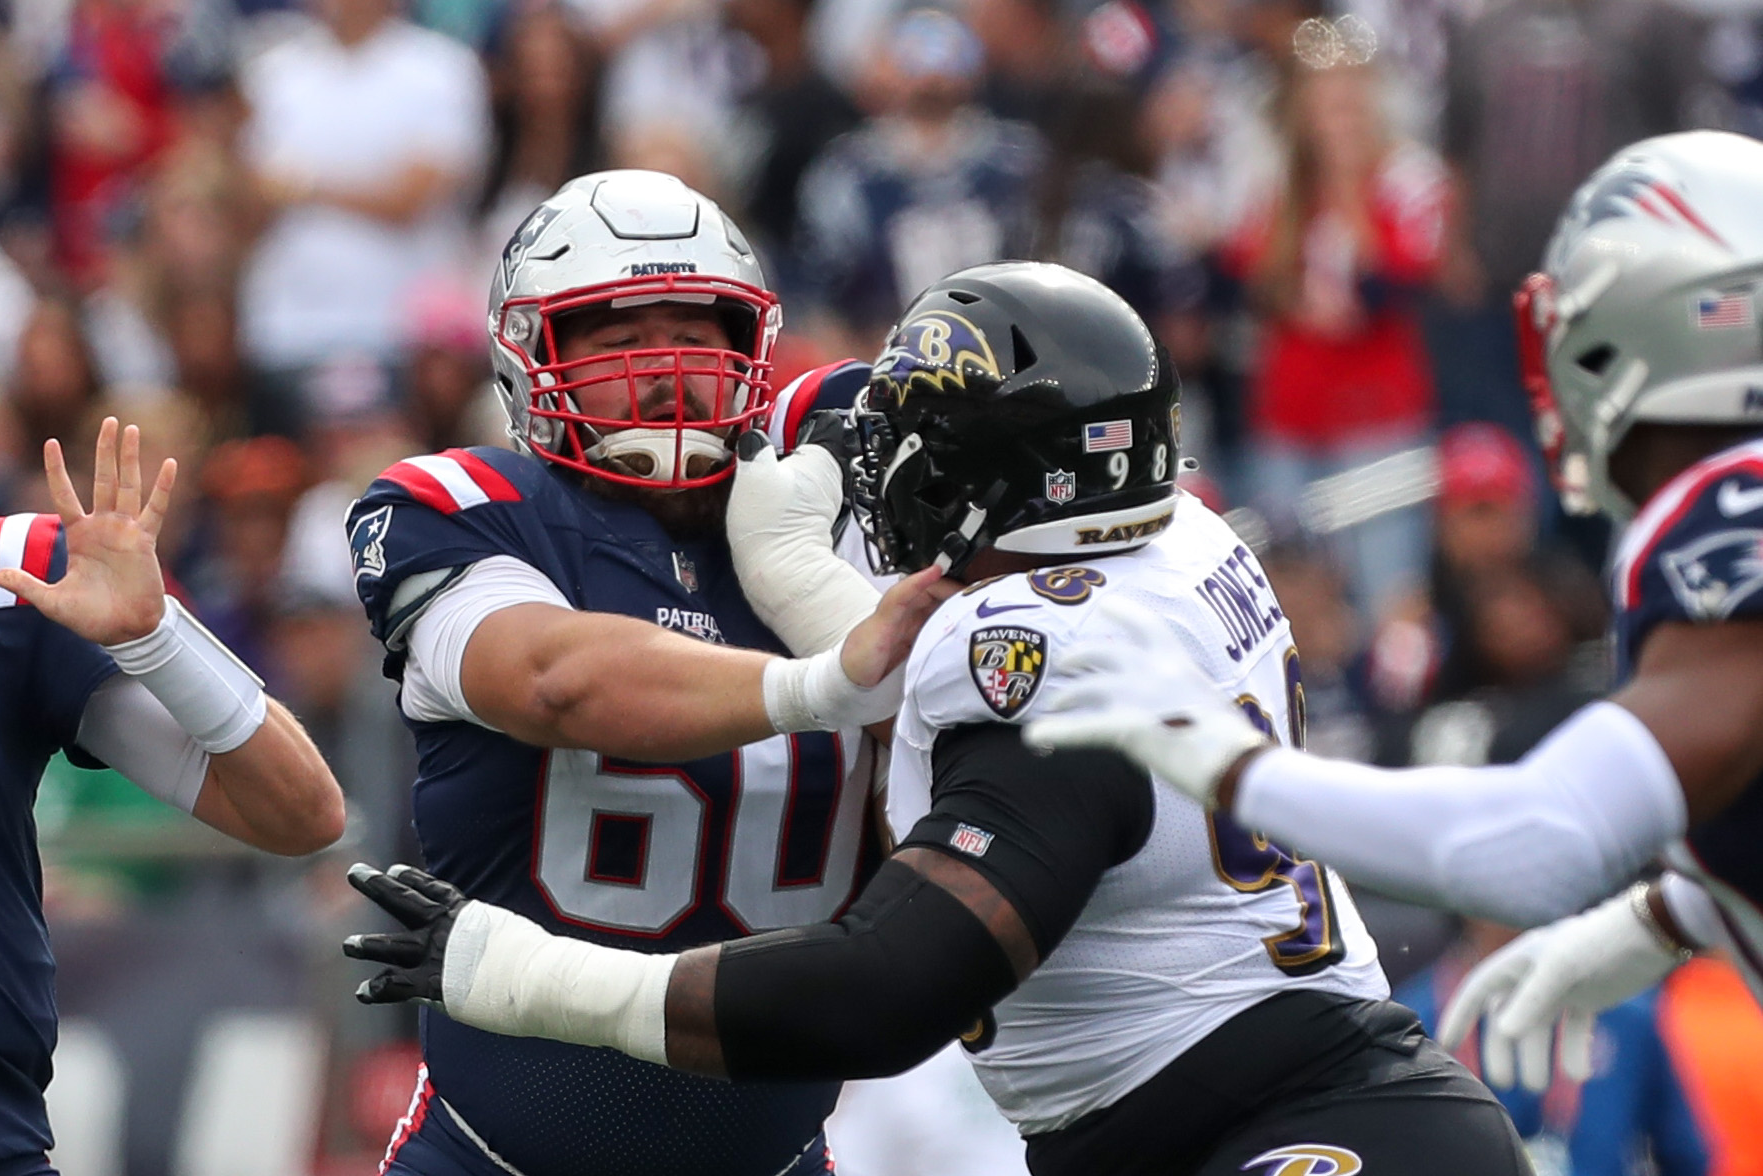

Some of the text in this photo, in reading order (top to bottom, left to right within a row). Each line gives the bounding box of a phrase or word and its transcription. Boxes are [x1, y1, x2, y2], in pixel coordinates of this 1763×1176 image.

[631, 262, 698, 277] PATRIOTS
[911, 317, 952, 363] B
[1074, 511, 1175, 546] RAVEN
[975, 628, 1041, 644] RAVENS
[530, 742, 878, 939] 60
